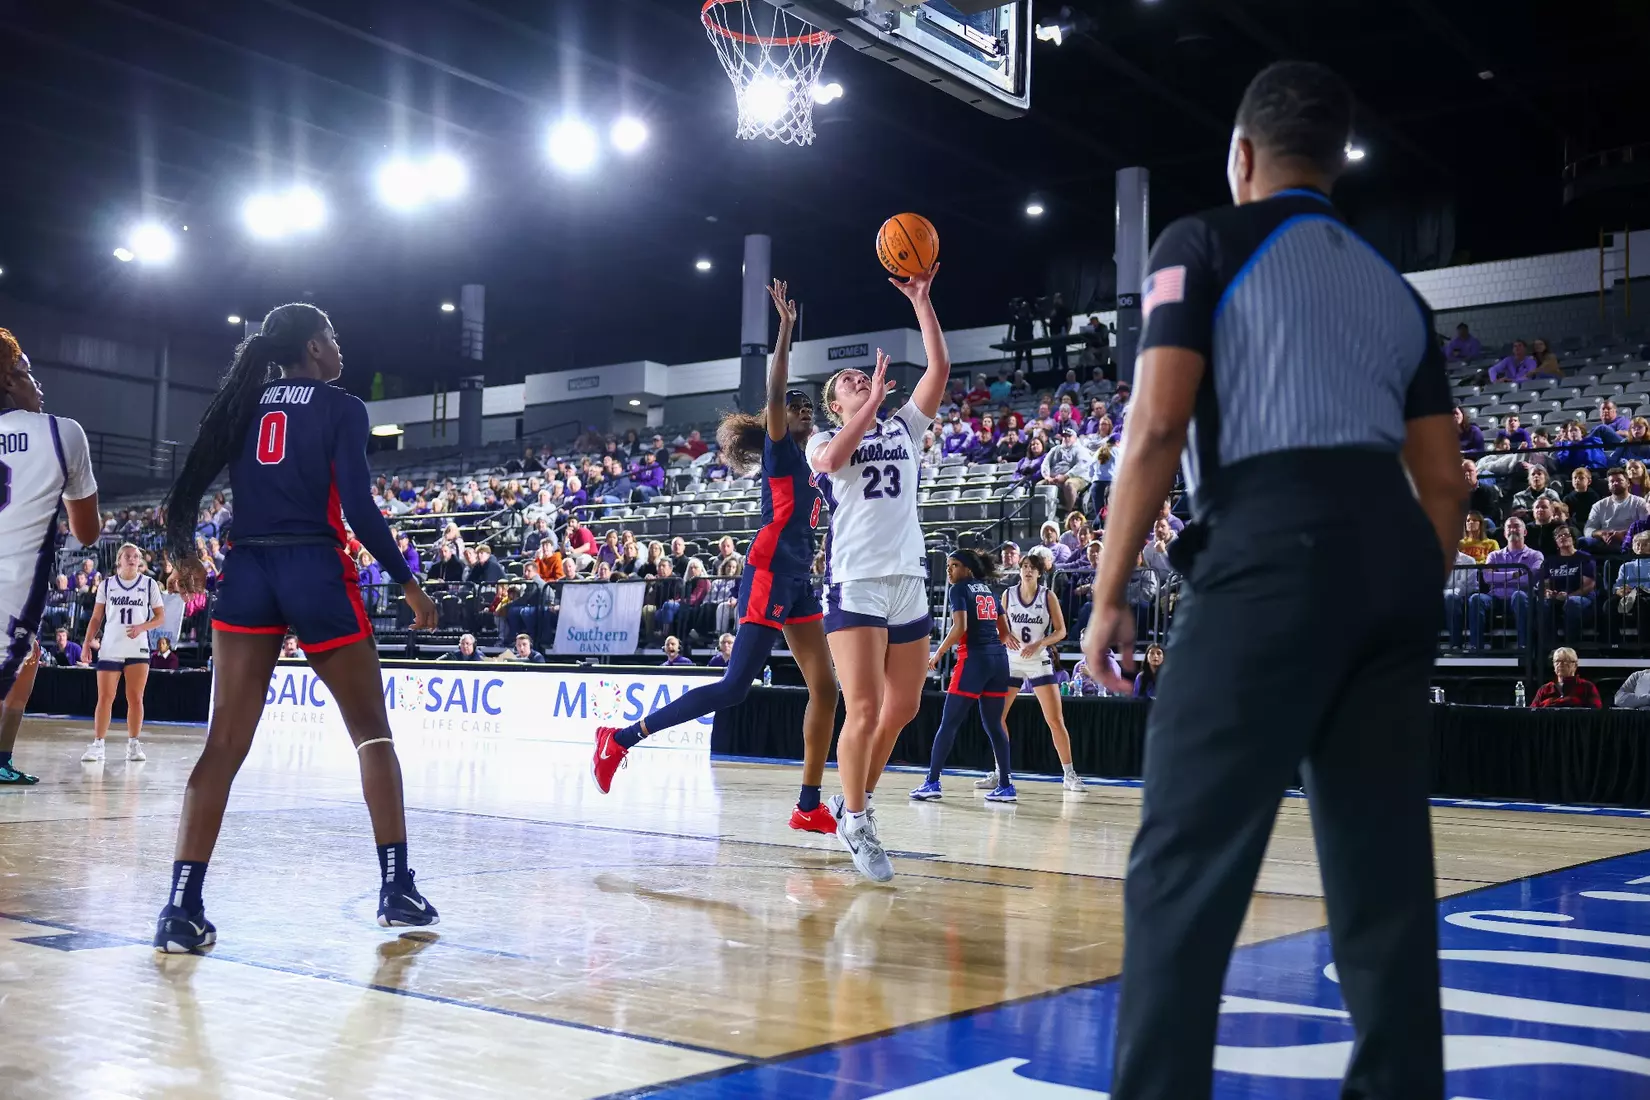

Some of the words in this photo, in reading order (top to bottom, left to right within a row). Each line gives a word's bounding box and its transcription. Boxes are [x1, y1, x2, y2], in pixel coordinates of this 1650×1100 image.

[829, 345, 867, 359] WOMEN
[256, 410, 288, 465] 0
[861, 464, 901, 500] 23
[110, 596, 143, 606] Wildcats
[976, 595, 998, 620] 22
[119, 607, 133, 625] 11
[1010, 612, 1043, 625] Wildcats
[567, 626, 628, 641] Southern
[1021, 626, 1031, 643] 6
[580, 643, 610, 653] BANK
[265, 674, 326, 707] SAIC
[291, 711, 325, 724] CARE
[423, 719, 453, 731] LIFE
[461, 720, 502, 733] CARE
[667, 730, 705, 745] CAR
